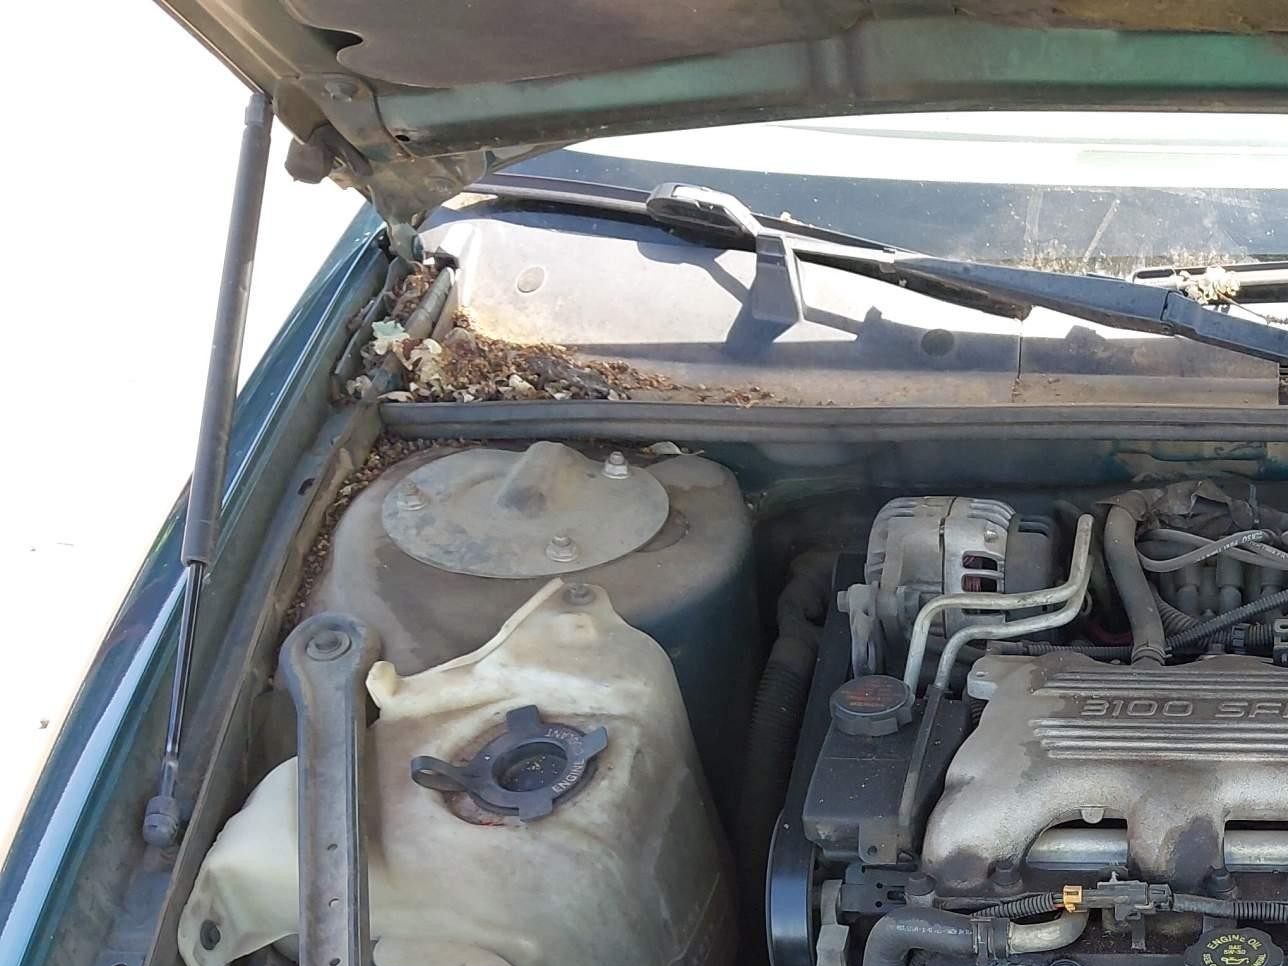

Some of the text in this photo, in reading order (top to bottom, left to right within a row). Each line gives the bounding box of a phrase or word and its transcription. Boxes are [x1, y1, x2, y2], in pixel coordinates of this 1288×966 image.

[1080, 700, 1194, 717] 3100
[1207, 934, 1263, 950] ENGINE OIL
[1202, 953, 1214, 965] SEE
